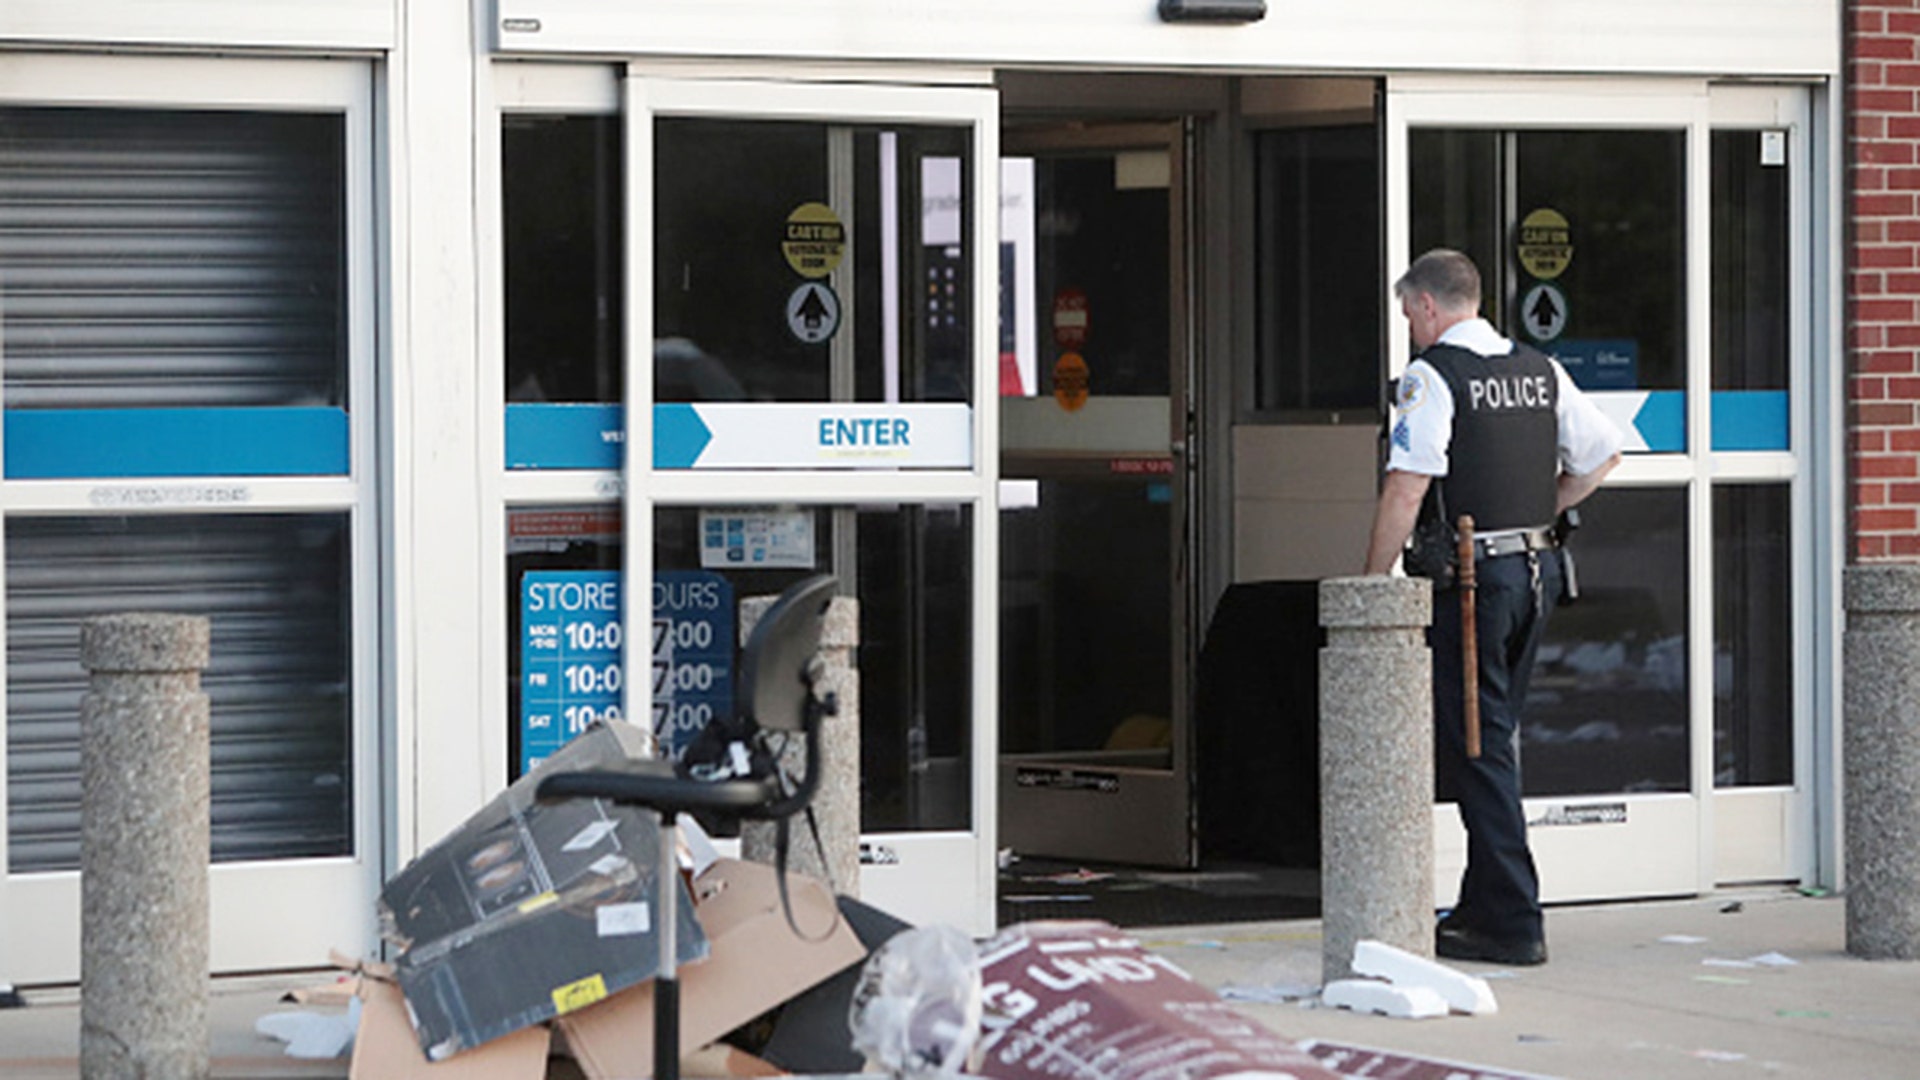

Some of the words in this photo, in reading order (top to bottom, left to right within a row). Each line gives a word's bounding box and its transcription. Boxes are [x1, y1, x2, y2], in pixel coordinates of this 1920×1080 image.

[1469, 377, 1550, 410] POLICE
[819, 418, 910, 446] ENTER
[528, 582, 617, 611] STORE
[652, 582, 720, 611] OURS
[564, 622, 622, 650] 10:0
[564, 664, 622, 693] 10:0
